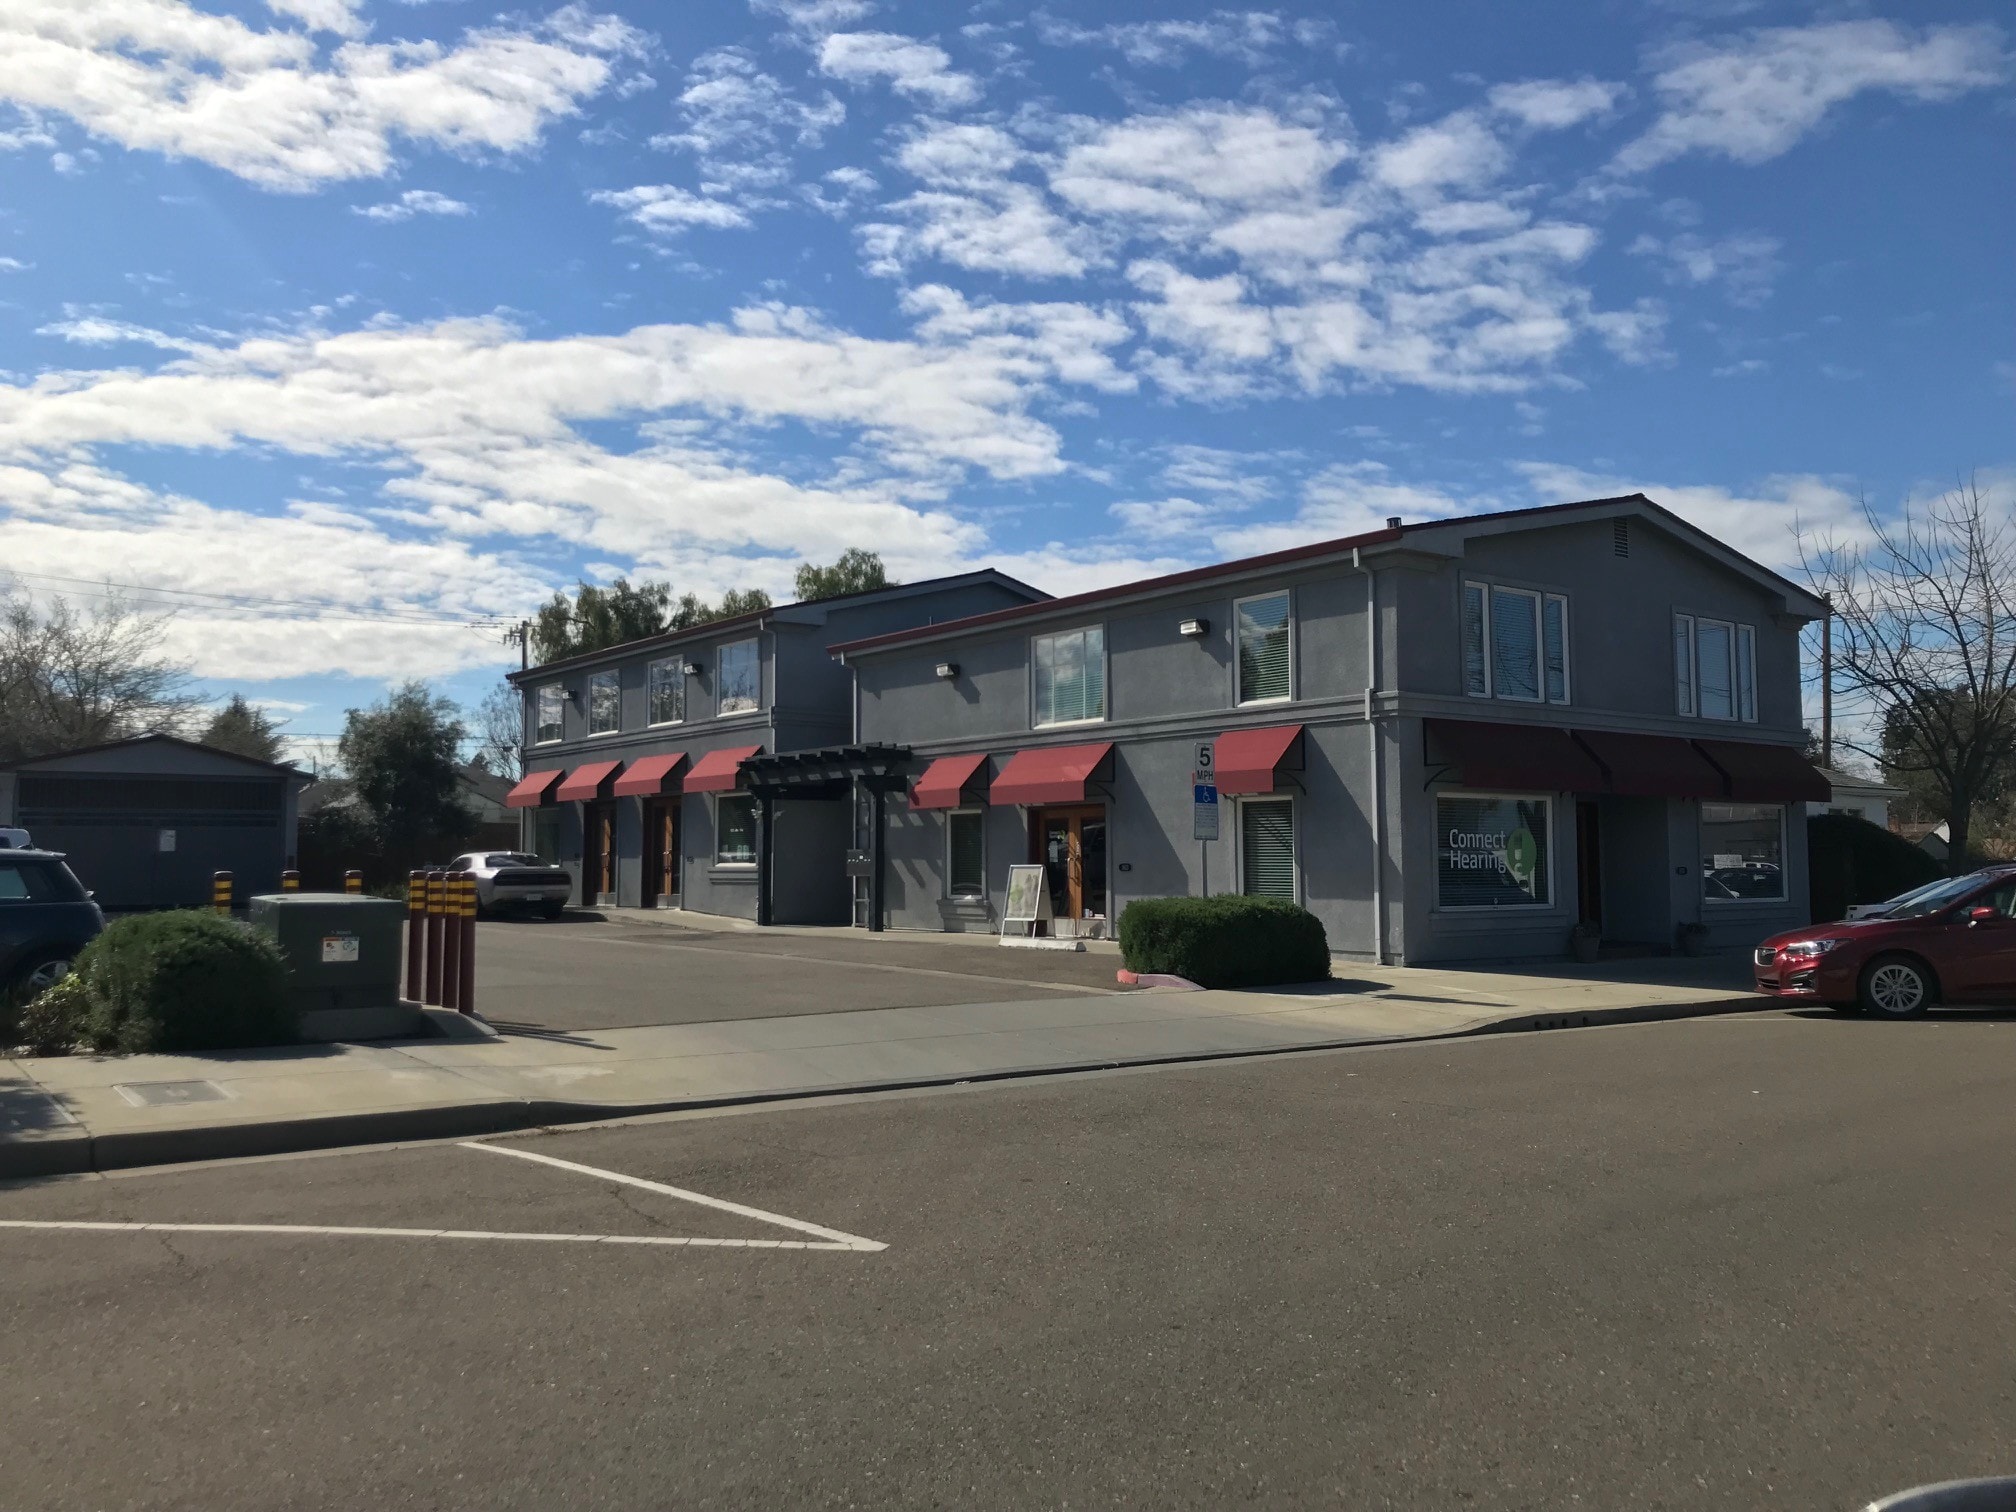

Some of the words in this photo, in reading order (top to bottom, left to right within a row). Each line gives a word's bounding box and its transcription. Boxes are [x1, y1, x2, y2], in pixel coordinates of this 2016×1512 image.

[1199, 747, 1211, 767] 5
[1197, 770, 1214, 781] MPH
[1449, 829, 1506, 848] Connect
[1450, 850, 1506, 874] Hearing
